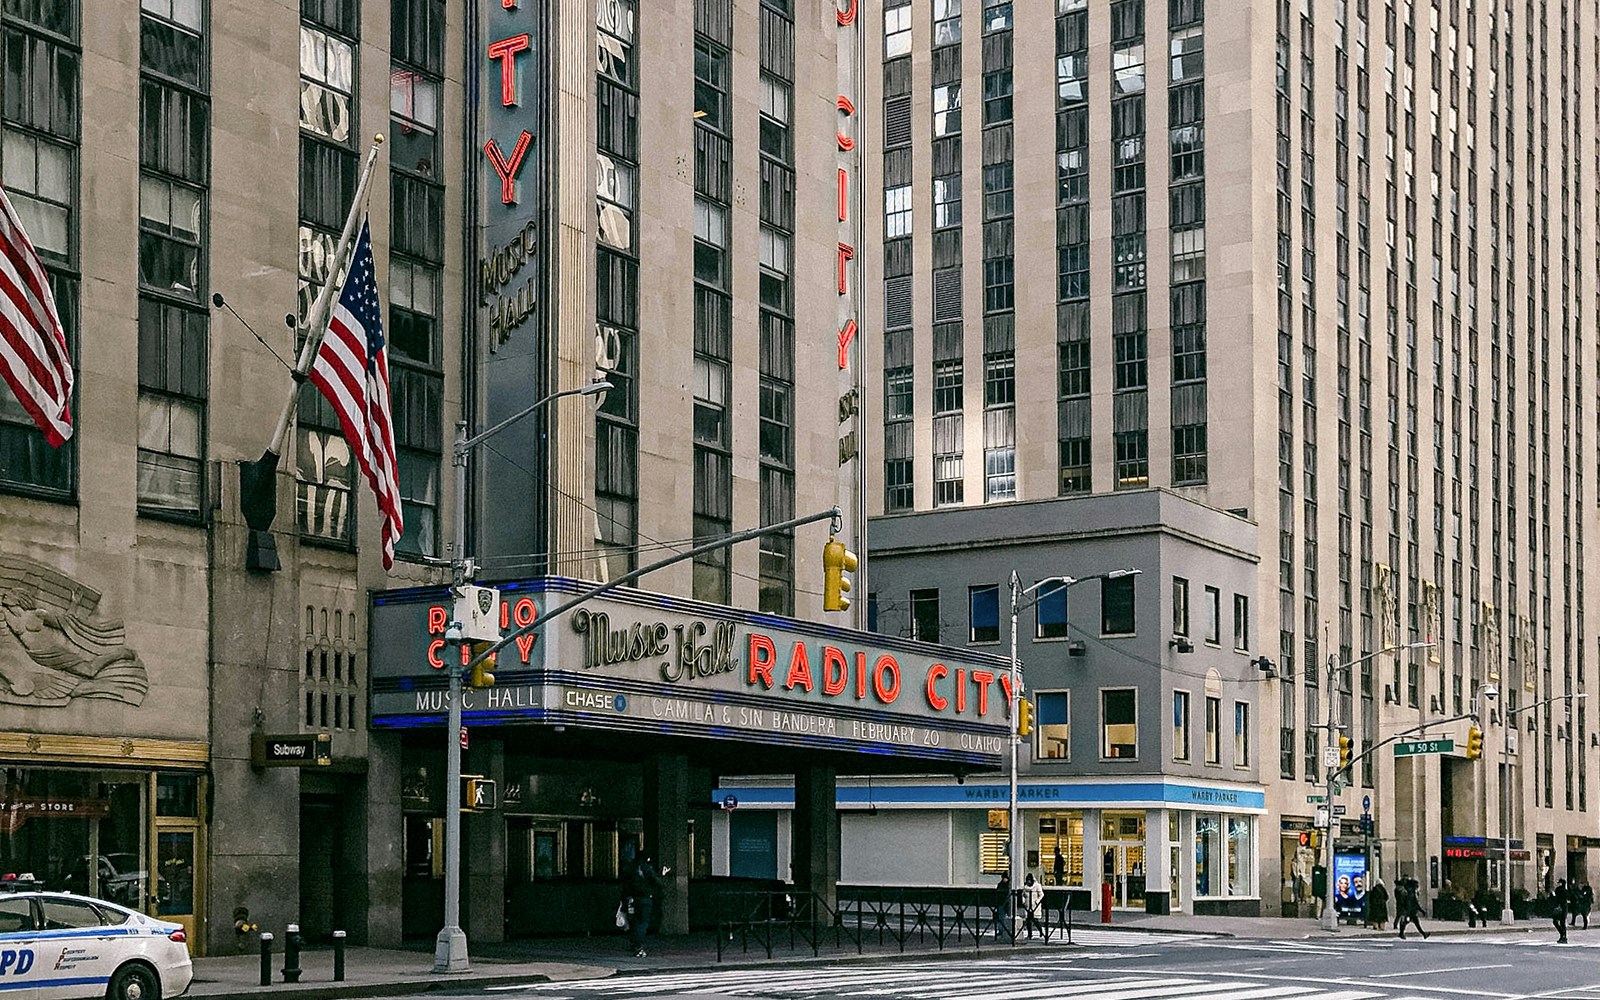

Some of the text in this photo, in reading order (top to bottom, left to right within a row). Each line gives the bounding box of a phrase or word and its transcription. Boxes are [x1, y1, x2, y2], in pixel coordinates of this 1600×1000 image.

[481, 221, 537, 304] MUSIC
[490, 277, 536, 353] HALL
[428, 597, 537, 634] RIO
[428, 632, 535, 668] CIY
[572, 607, 1021, 717] Music Hall RADIO CITY
[416, 686, 539, 711] MUSC HALL
[566, 691, 612, 709] CHASE
[722, 706, 731, 724] &
[740, 707, 763, 727] SIN
[773, 714, 836, 736] BANDERA
[853, 721, 915, 744] FEBRUARY
[923, 729, 940, 746] 20
[961, 733, 1001, 752] CLAIRO
[273, 743, 306, 757] Subway
[1418, 743, 1427, 752] 50
[1430, 742, 1438, 751] St
[965, 788, 1060, 799] WARBY ARKER
[1191, 790, 1238, 803] WARBY PARKER
[40, 803, 74, 811] STORE
